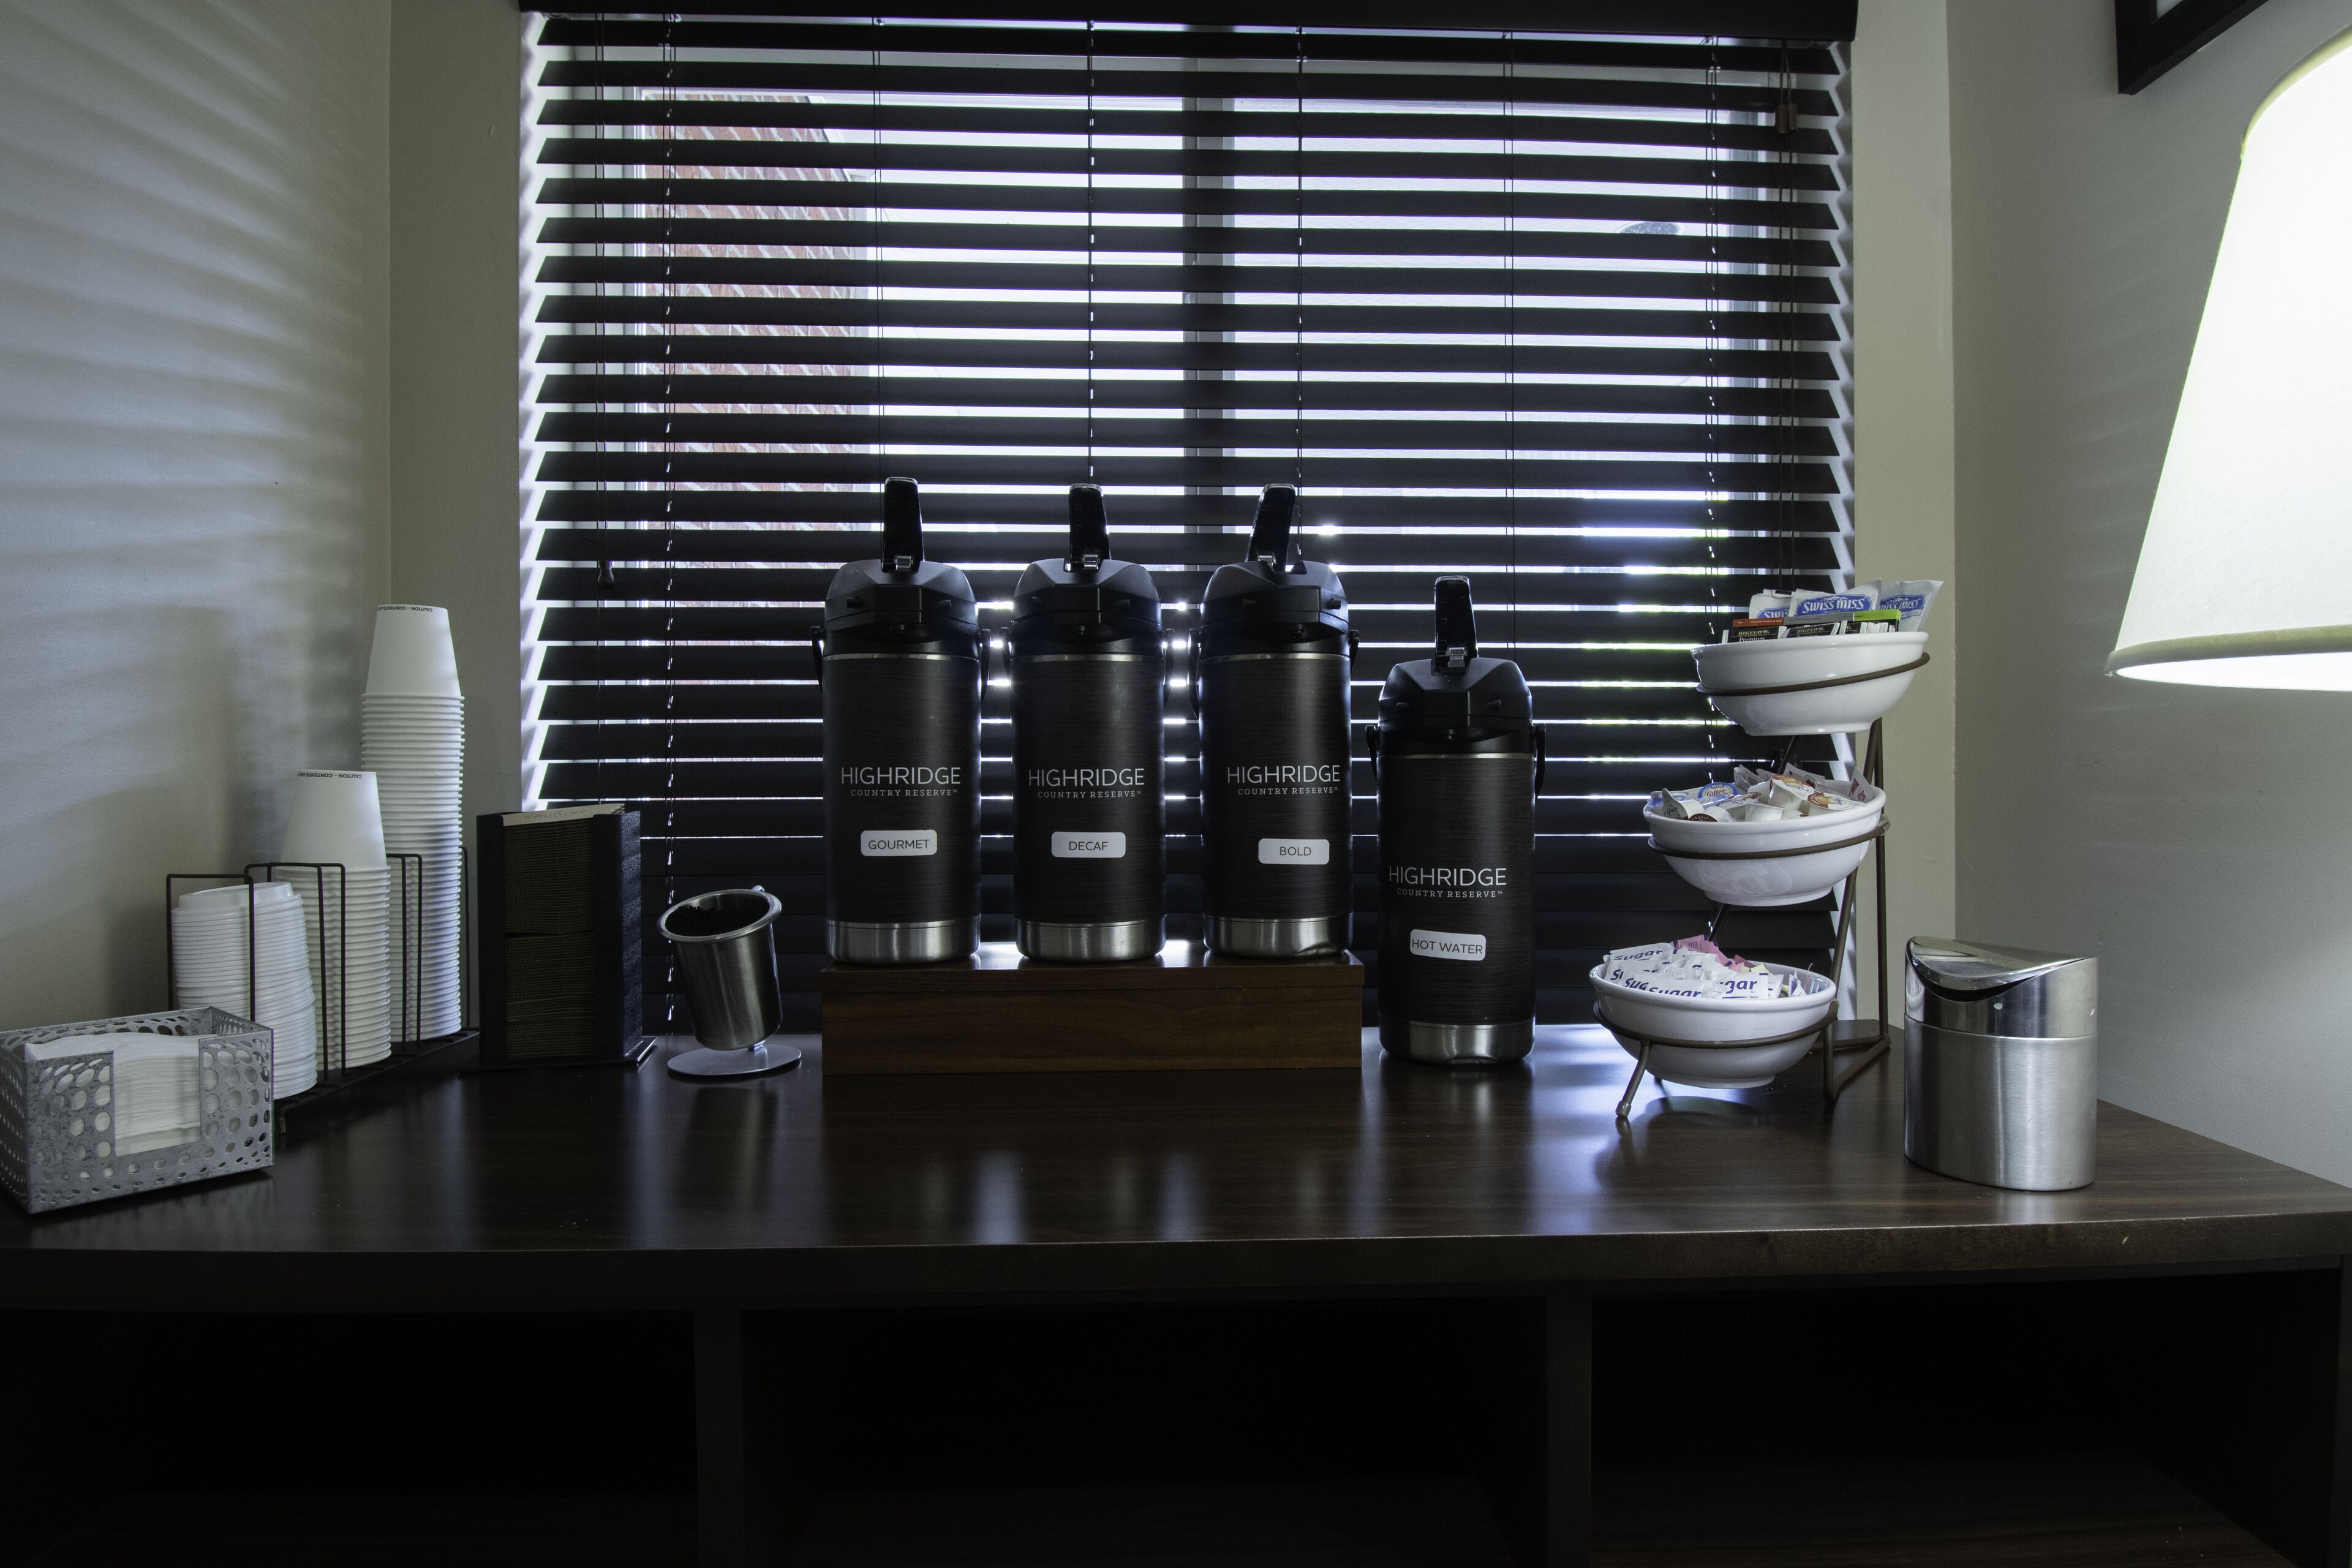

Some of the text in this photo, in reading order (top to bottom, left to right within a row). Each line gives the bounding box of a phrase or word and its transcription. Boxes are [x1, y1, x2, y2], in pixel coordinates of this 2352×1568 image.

[841, 767, 961, 785] HIGHRIDGE
[1028, 767, 1145, 786] HIGHRIDGE
[1227, 764, 1340, 784] HIGHRIDGE
[869, 839, 930, 850] GOURMET
[1069, 841, 1108, 851] DECAF
[1280, 846, 1311, 856] BOLD
[1389, 865, 1507, 886] HIGHRIDGE
[1396, 888, 1443, 897] COUNTRY
[1412, 938, 1483, 954] HOT WATER
